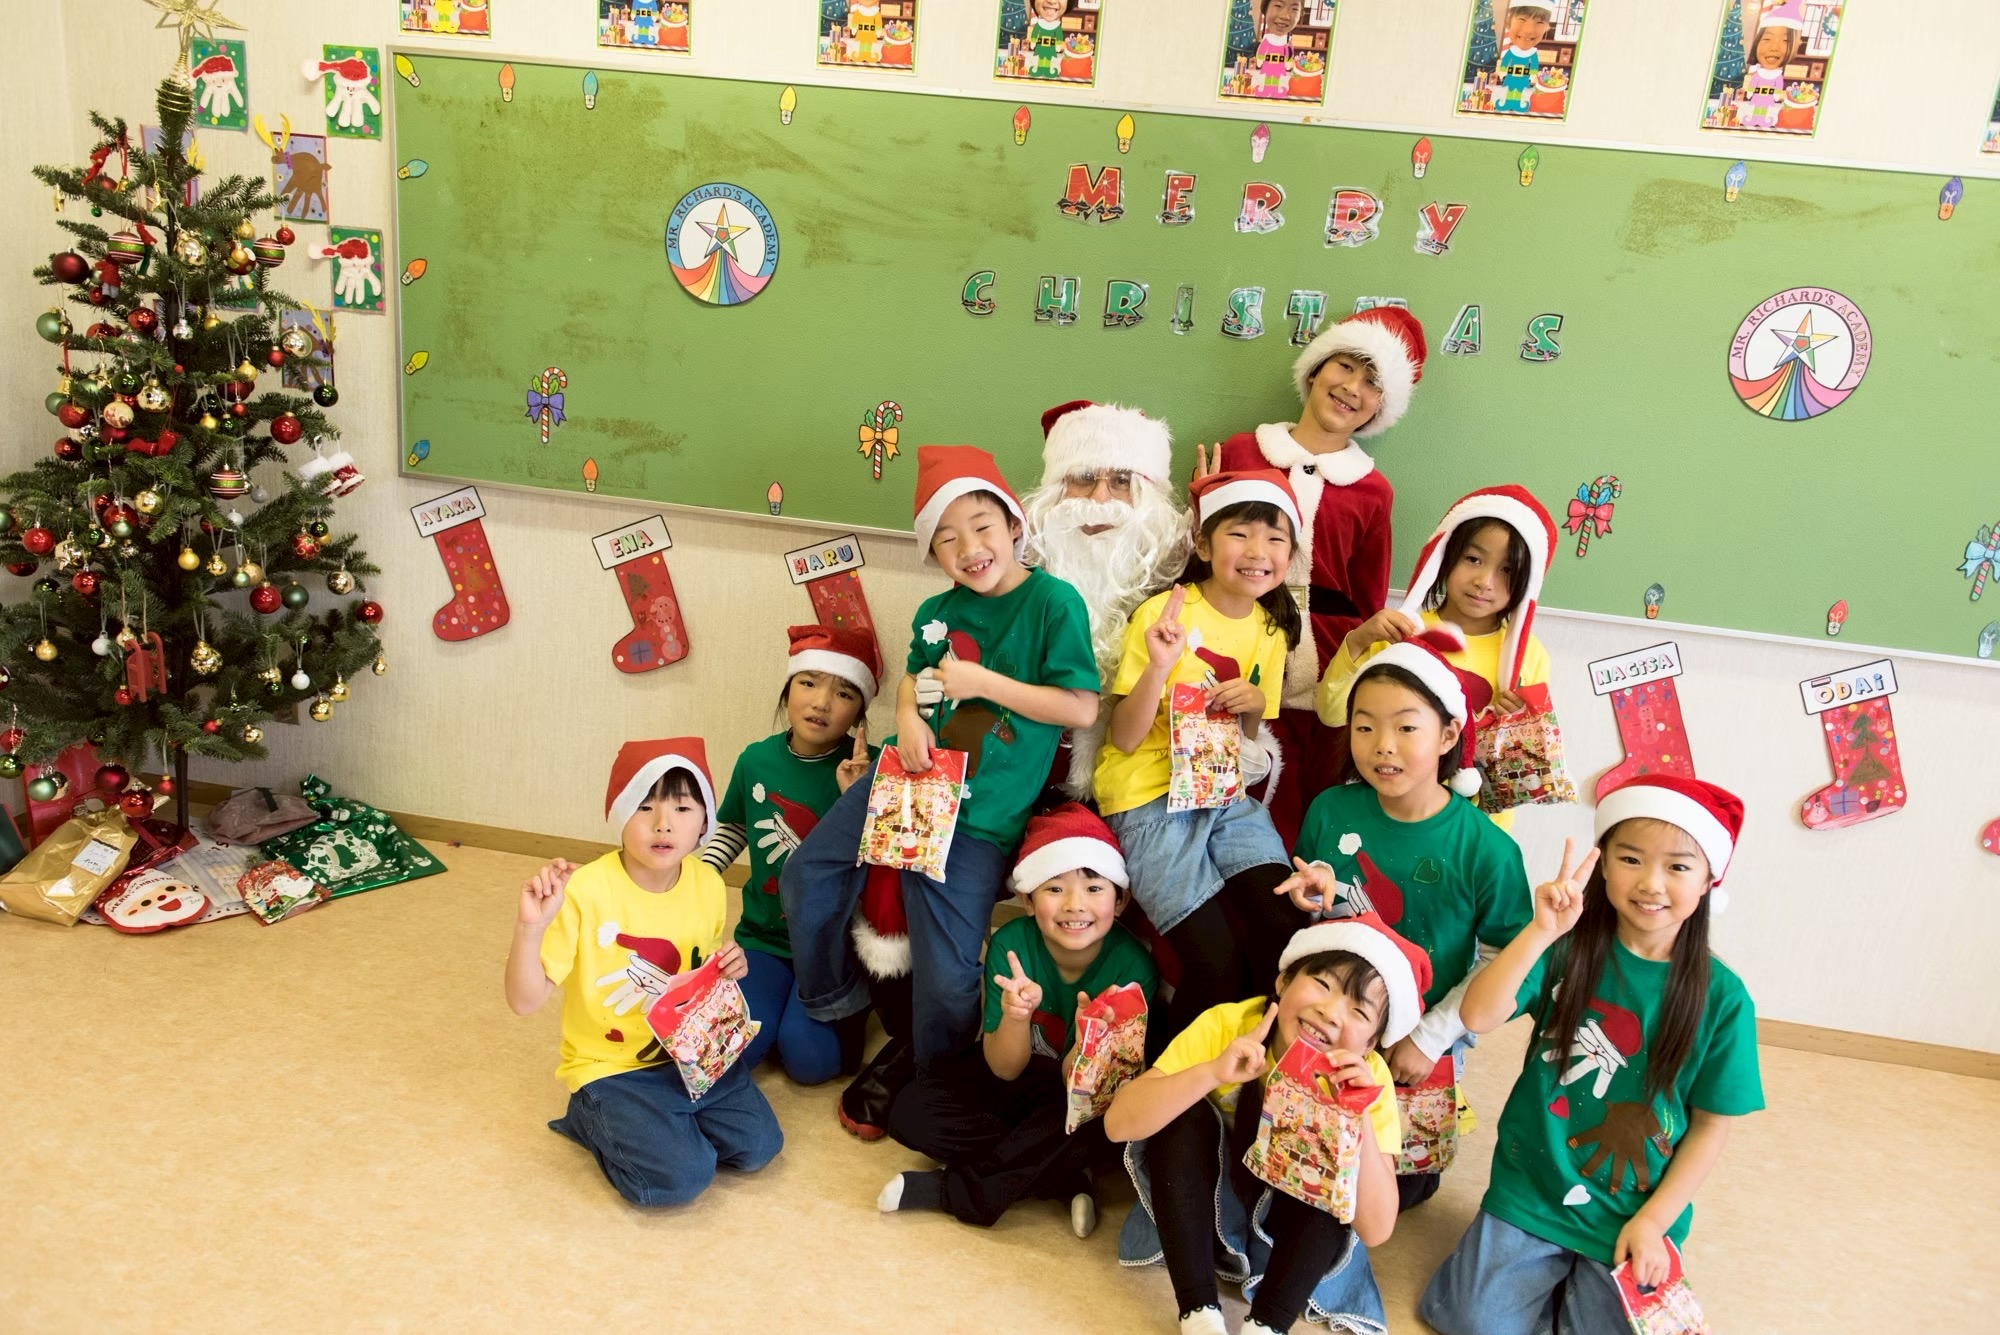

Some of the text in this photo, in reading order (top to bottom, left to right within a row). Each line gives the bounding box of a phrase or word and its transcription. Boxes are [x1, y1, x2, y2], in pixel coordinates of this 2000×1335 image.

[668, 186, 776, 266] MR. RICHARD'S ACADEMY
[1056, 164, 1468, 256] MERRY
[962, 271, 1564, 362] CHRISTAS
[1732, 290, 1867, 378] MR. RICHARD'S ACADEMY
[420, 497, 476, 527] AYAKA
[609, 530, 654, 558] ENA
[793, 544, 854, 575] HARU
